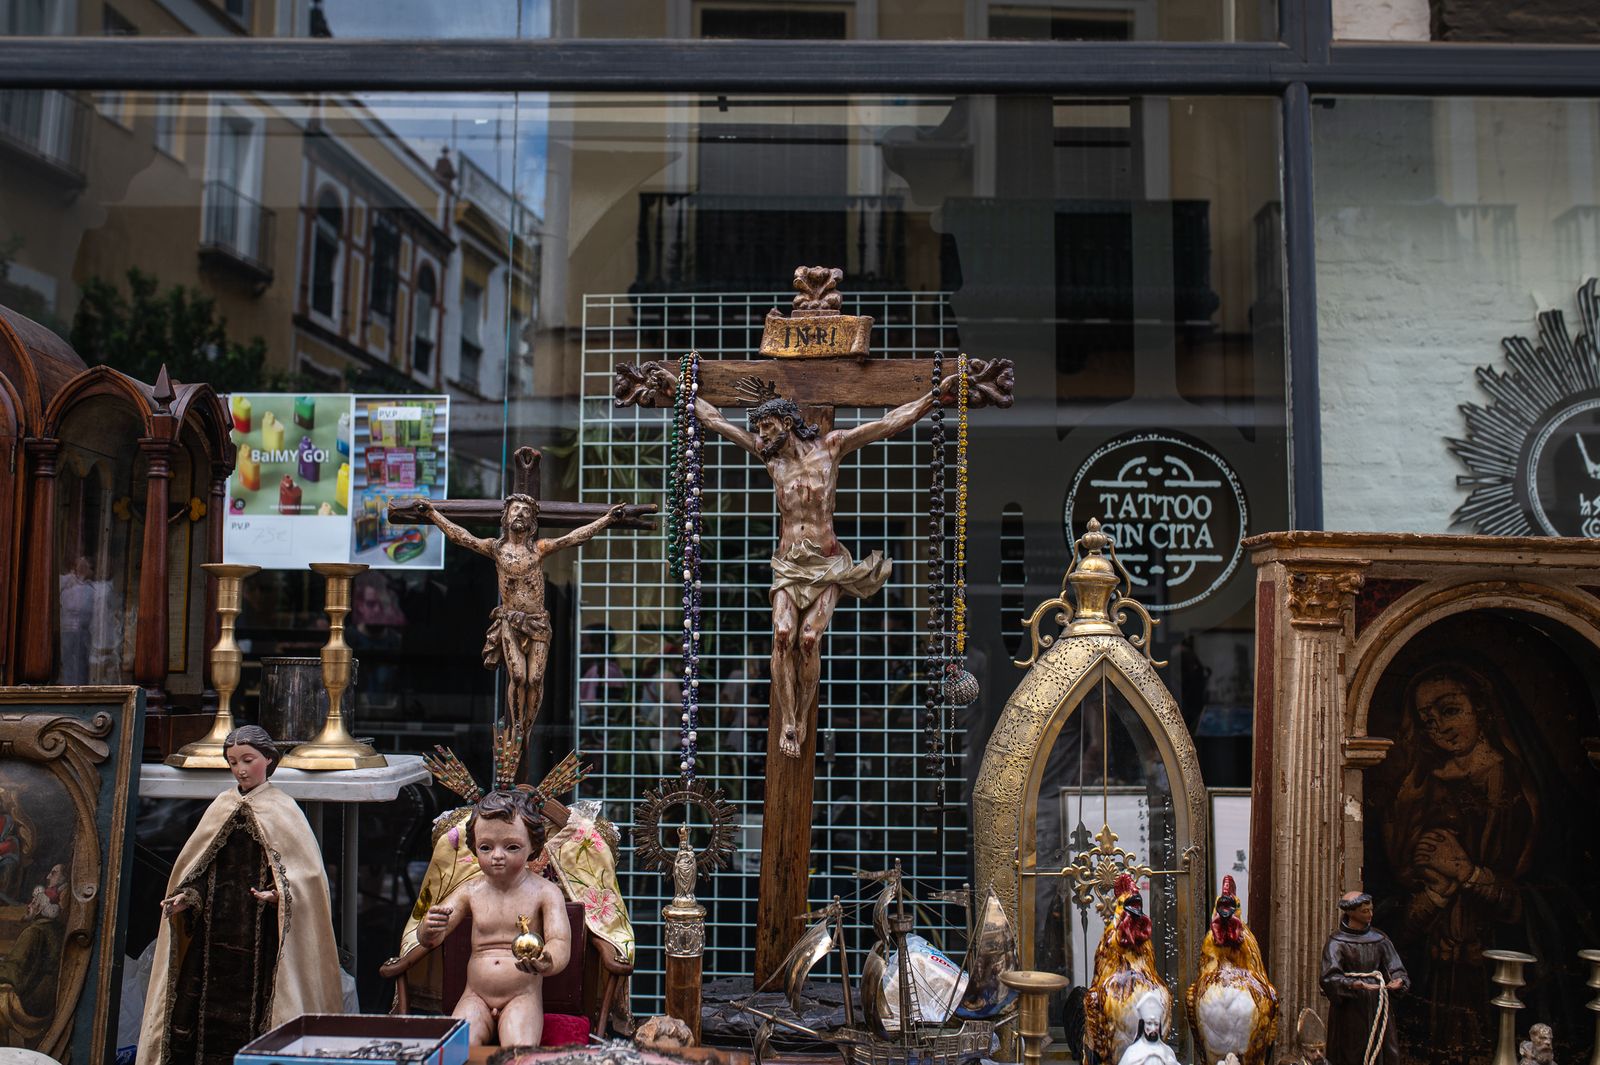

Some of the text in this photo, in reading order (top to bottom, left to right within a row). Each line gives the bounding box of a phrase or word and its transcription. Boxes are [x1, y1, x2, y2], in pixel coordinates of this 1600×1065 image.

[251, 449, 329, 463] BalMY GO!
[1100, 493, 1213, 521] TATTOO
[1100, 523, 1214, 549] SIN CITA
